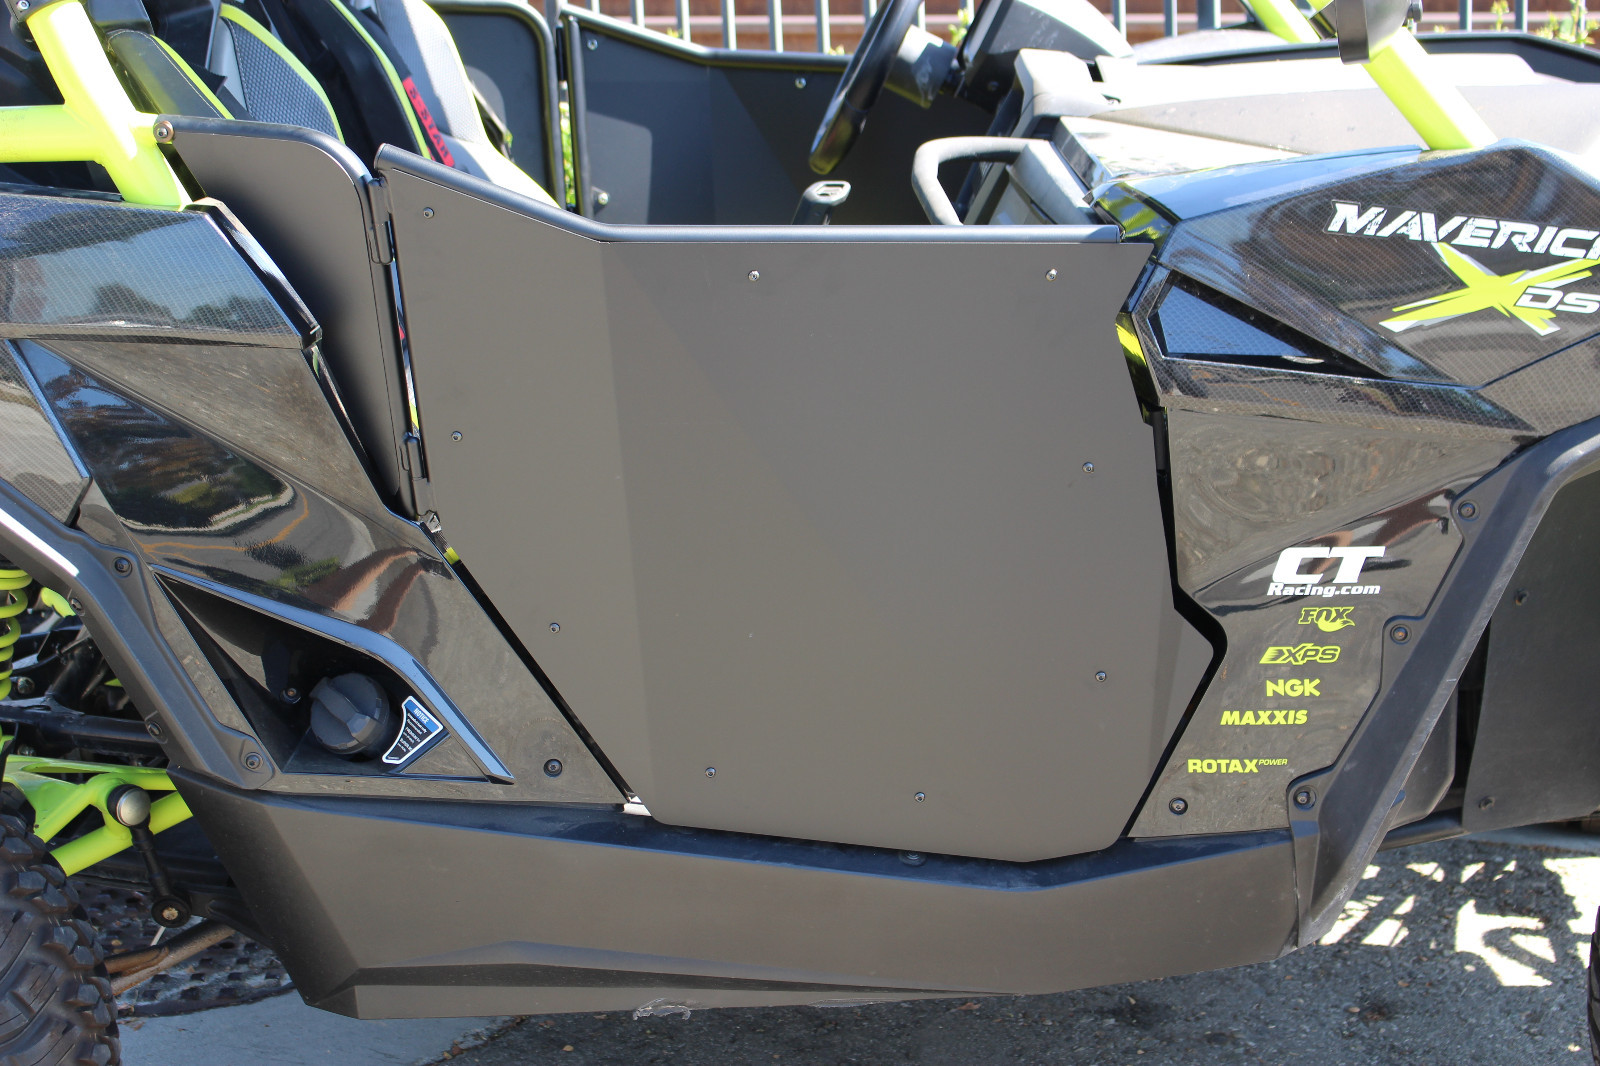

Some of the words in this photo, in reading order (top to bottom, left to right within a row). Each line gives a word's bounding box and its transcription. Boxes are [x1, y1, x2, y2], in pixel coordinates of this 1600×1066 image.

[1272, 546, 1386, 584] CT
[1267, 582, 1381, 598] Racing.com
[1298, 606, 1356, 633] FOX
[1266, 678, 1321, 697] NGK
[413, 707, 429, 724] NOTICE
[1220, 709, 1308, 726] MAXXIS
[1187, 758, 1259, 774] ROTAX
[1258, 758, 1288, 766] POWER
